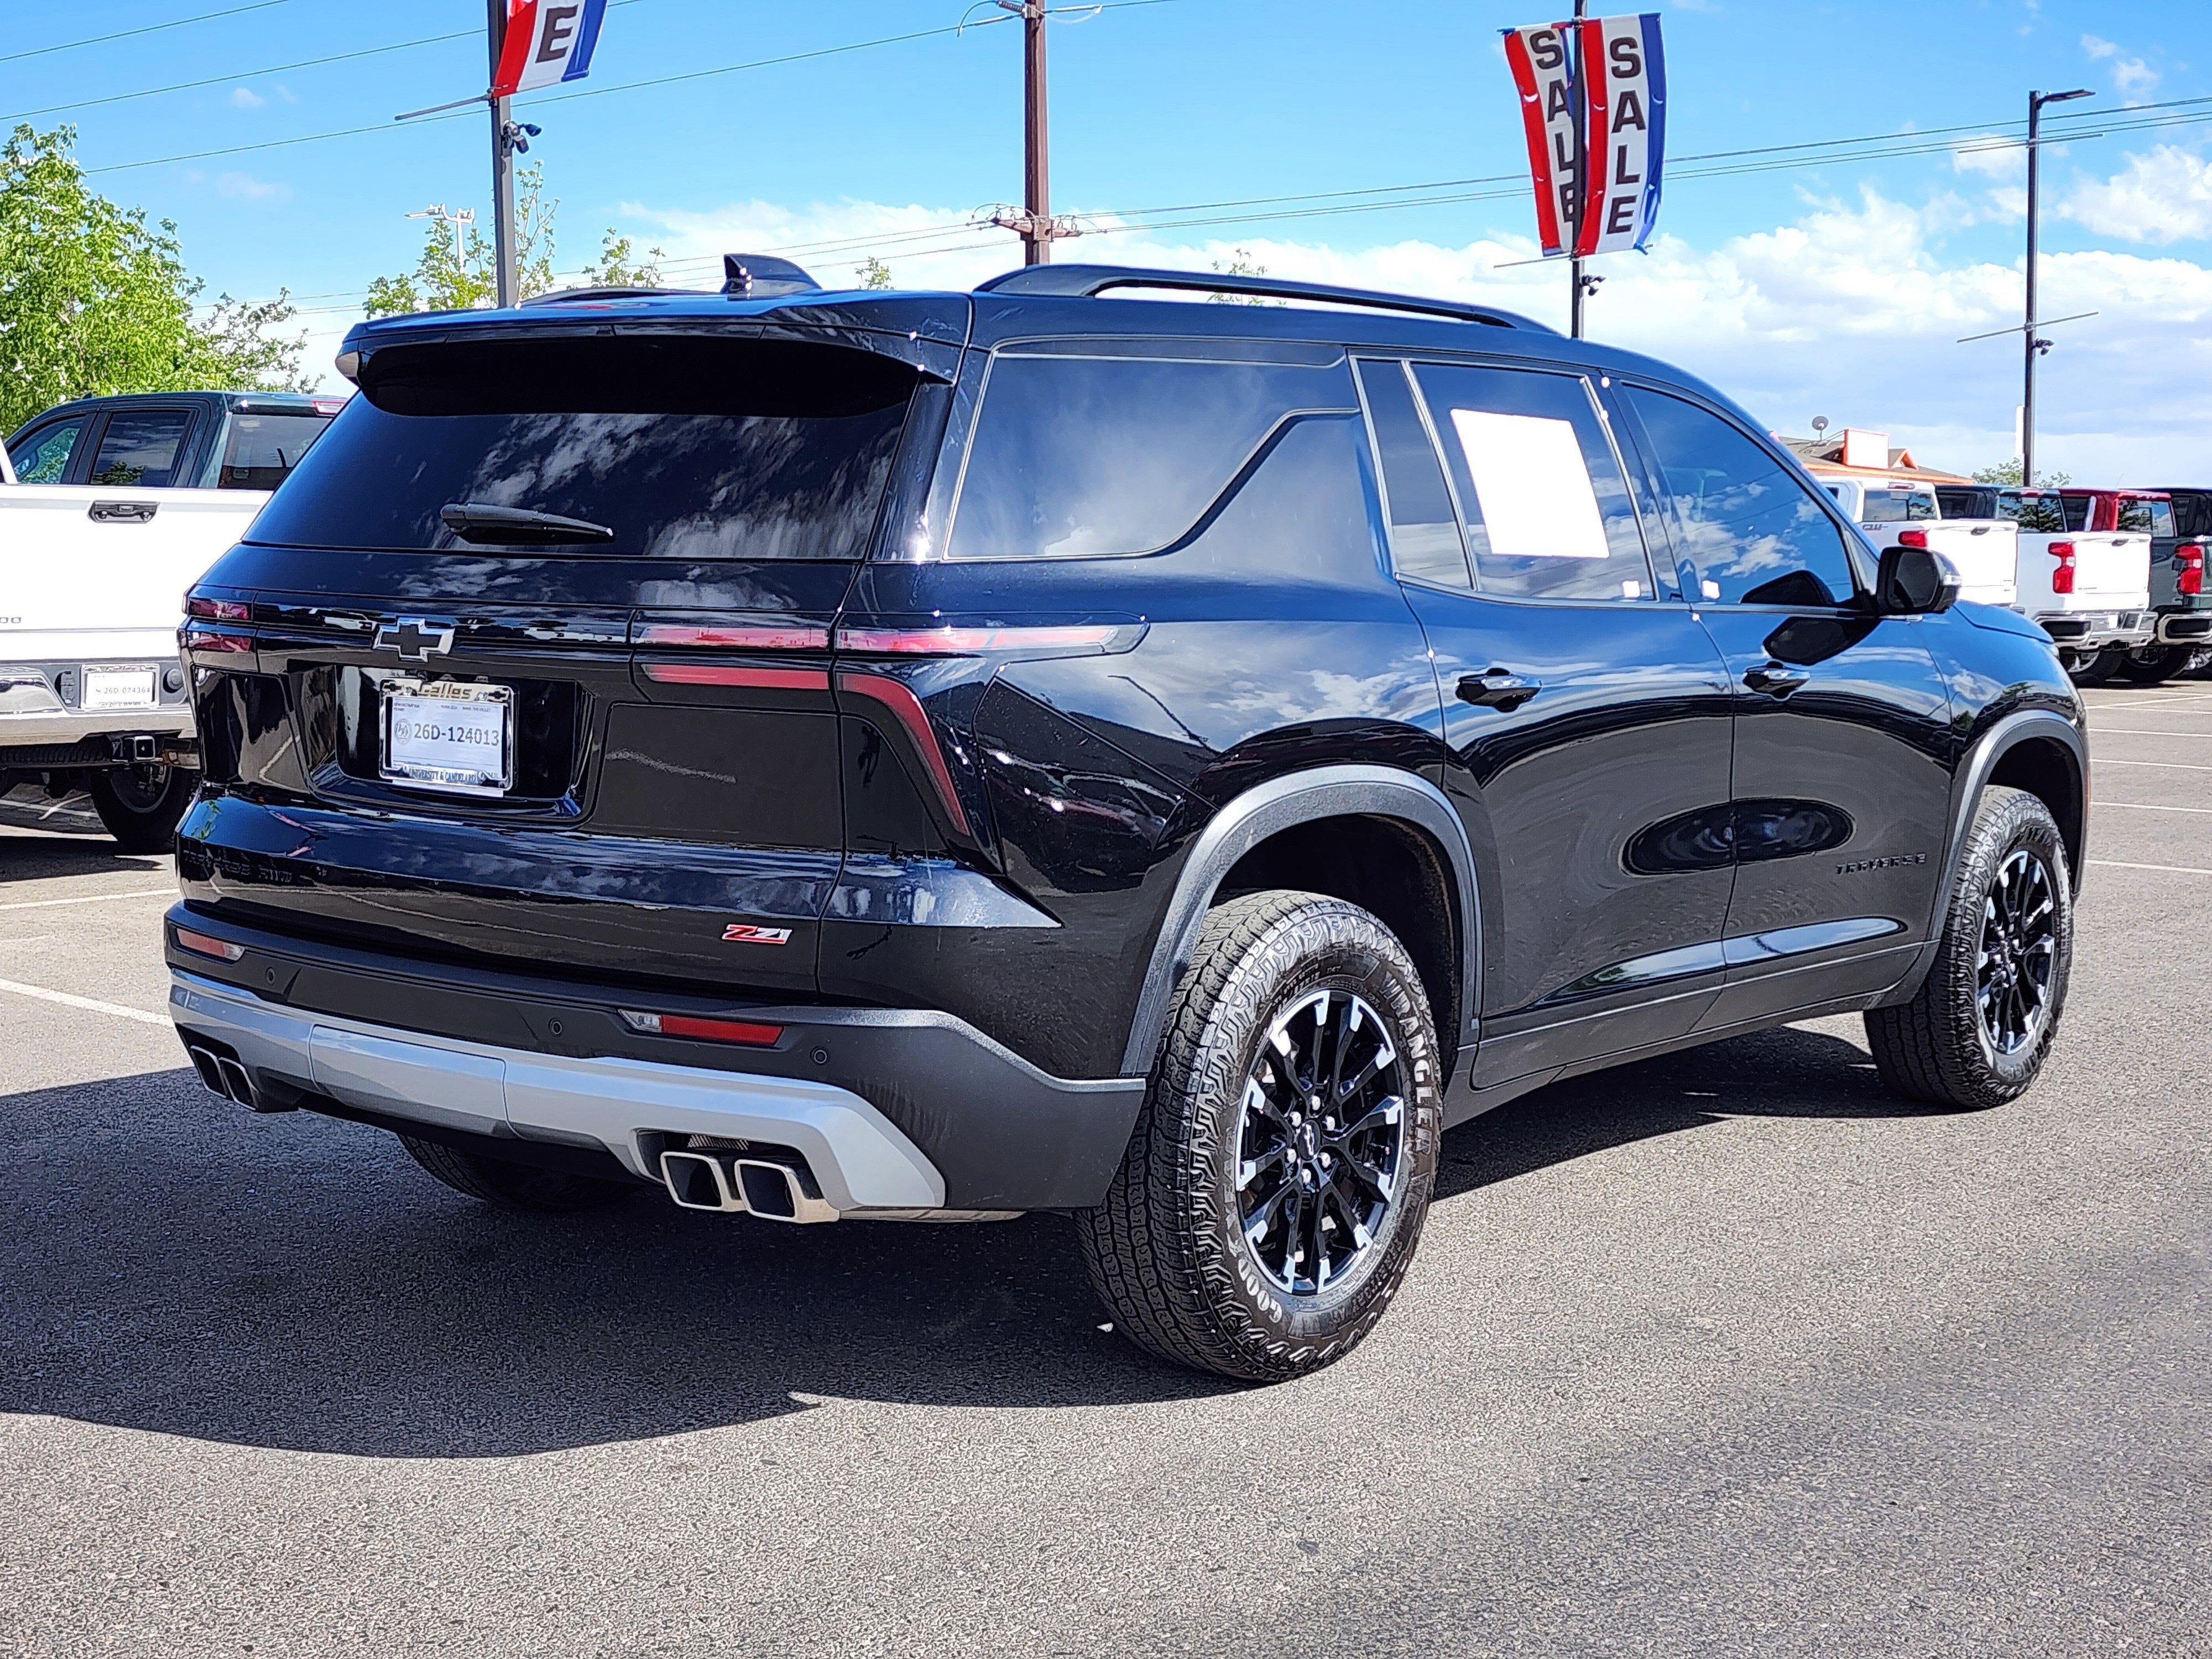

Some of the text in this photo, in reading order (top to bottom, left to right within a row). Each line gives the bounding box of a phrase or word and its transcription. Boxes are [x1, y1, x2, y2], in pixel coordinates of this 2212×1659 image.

[535, 4, 578, 64] E
[1606, 37, 1646, 234] SALE
[414, 723, 499, 747] 26D-124013
[722, 924, 792, 945] Z71
[1380, 971, 1433, 1155] WRANGLER
